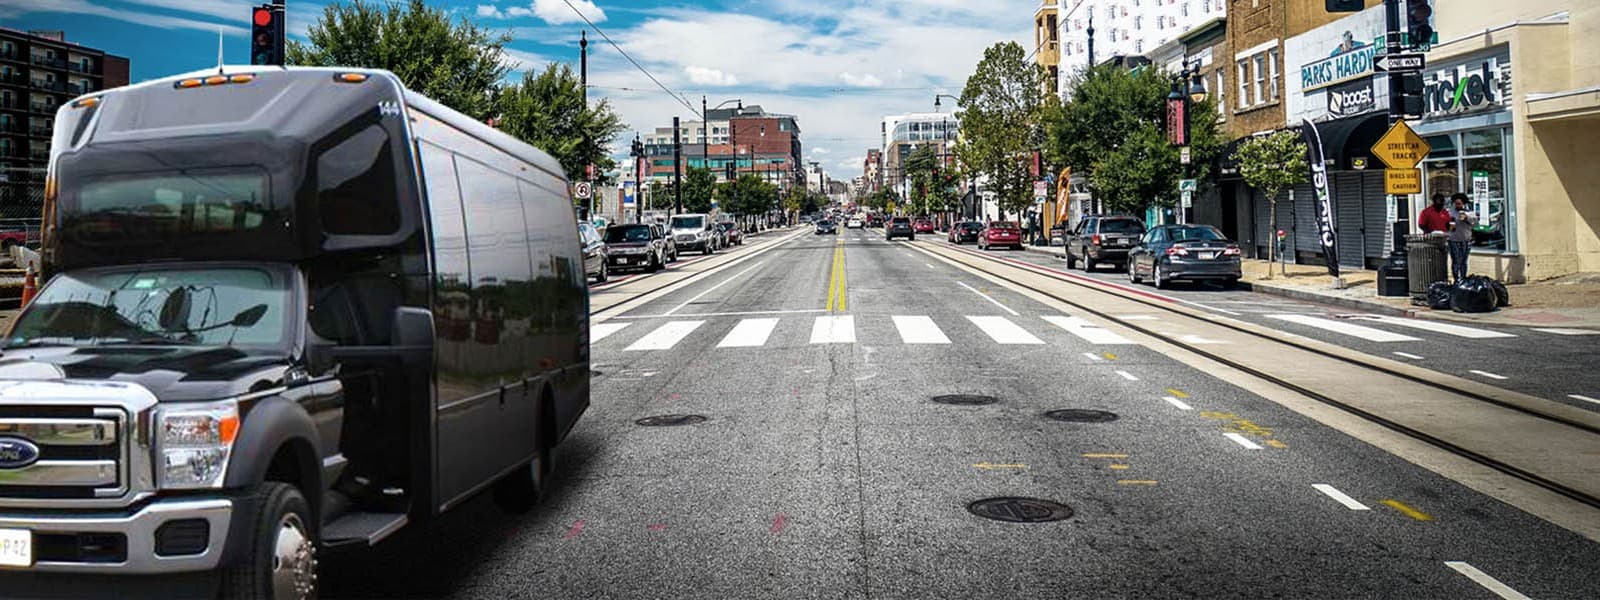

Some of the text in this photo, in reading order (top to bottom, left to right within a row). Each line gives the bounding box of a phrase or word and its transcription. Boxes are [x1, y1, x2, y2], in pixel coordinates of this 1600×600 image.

[1301, 60, 1332, 88] PARKS
[1388, 60, 1402, 68] ONE
[1342, 86, 1371, 106] boost
[1424, 62, 1494, 111] ricket
[1392, 152, 1417, 160] TRACKS
